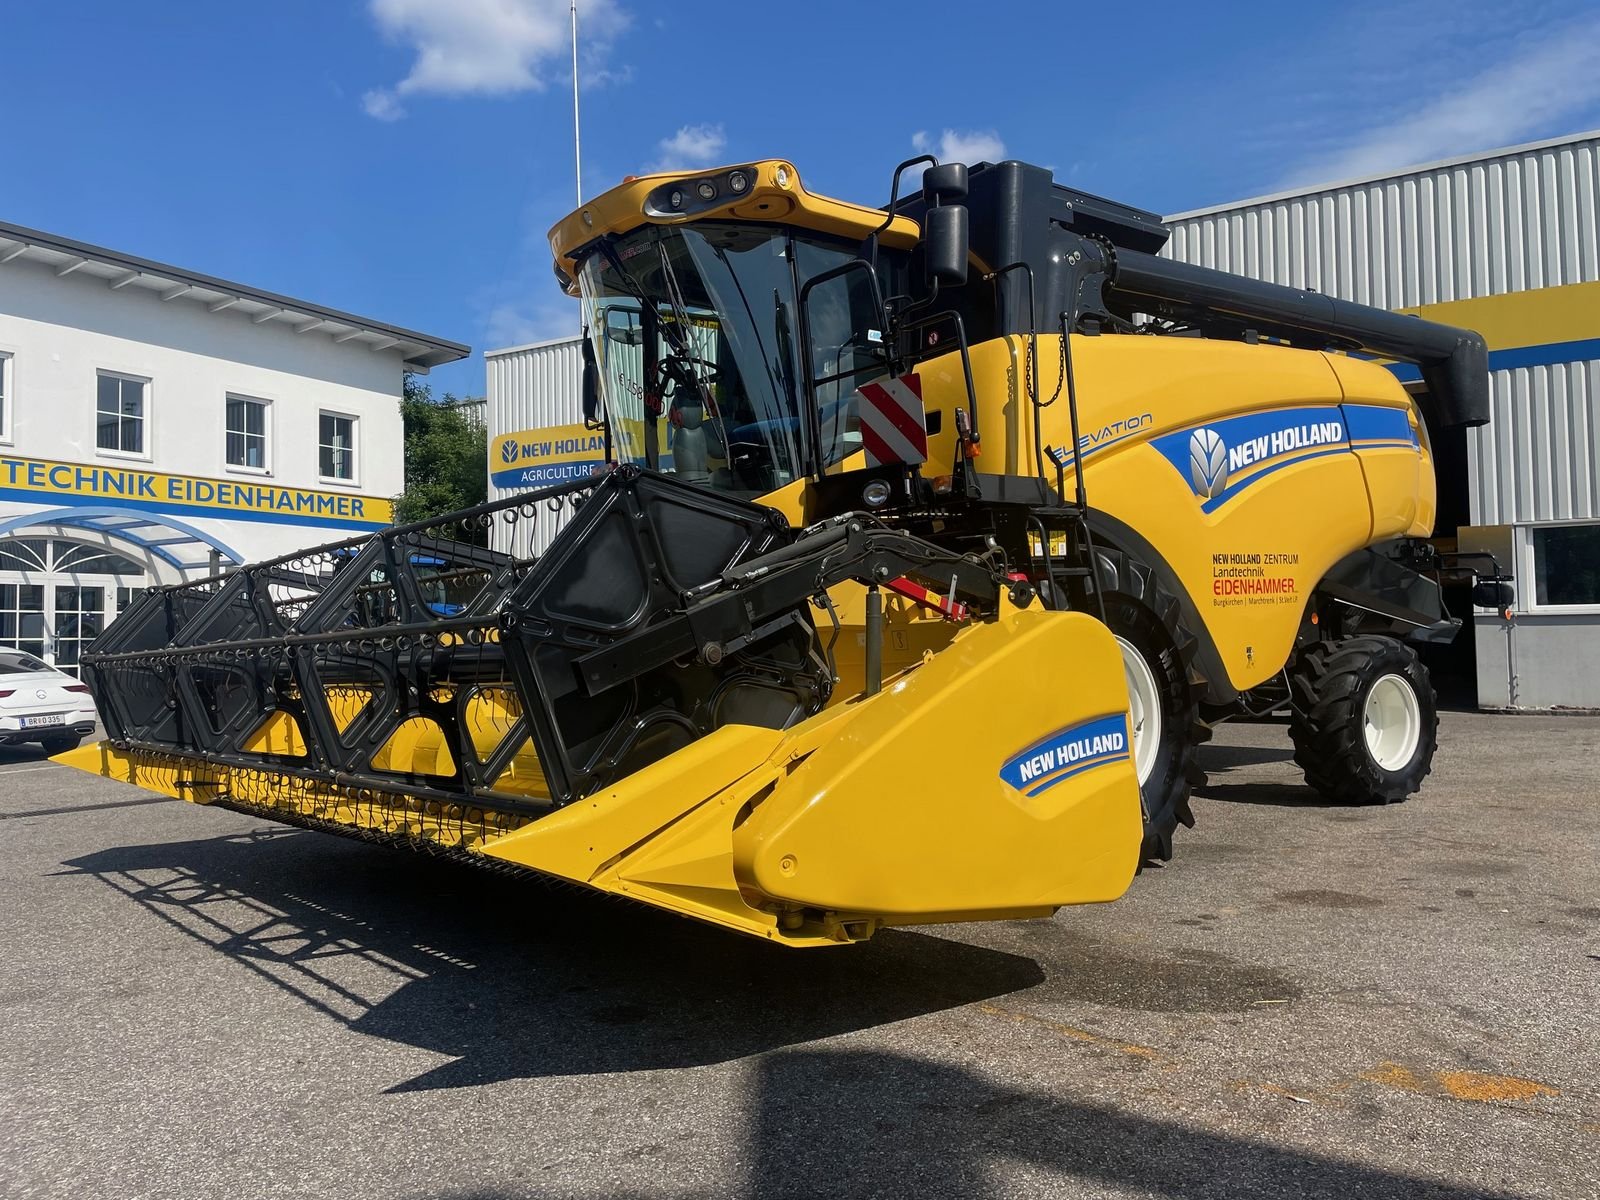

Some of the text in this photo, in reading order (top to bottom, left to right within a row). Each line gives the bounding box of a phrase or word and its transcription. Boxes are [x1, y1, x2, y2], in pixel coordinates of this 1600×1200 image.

[1052, 413, 1153, 460] ELEVATION
[521, 441, 551, 459] NEW
[1229, 422, 1342, 472] NEW HOLLAND
[1, 459, 365, 518] TECHNIK EIDENHAMMER
[1212, 553, 1299, 565] NEW HOLLAND ZENTRUM
[1213, 566, 1265, 578] Landtechnik
[1213, 578, 1295, 596] EIDENHAMMER
[1213, 597, 1244, 608] Burgkirchen
[1248, 596, 1275, 605] Marchtrenk
[28, 717, 38, 725] BR
[1019, 750, 1055, 783] NEW
[1056, 732, 1124, 766] HOLLAND
